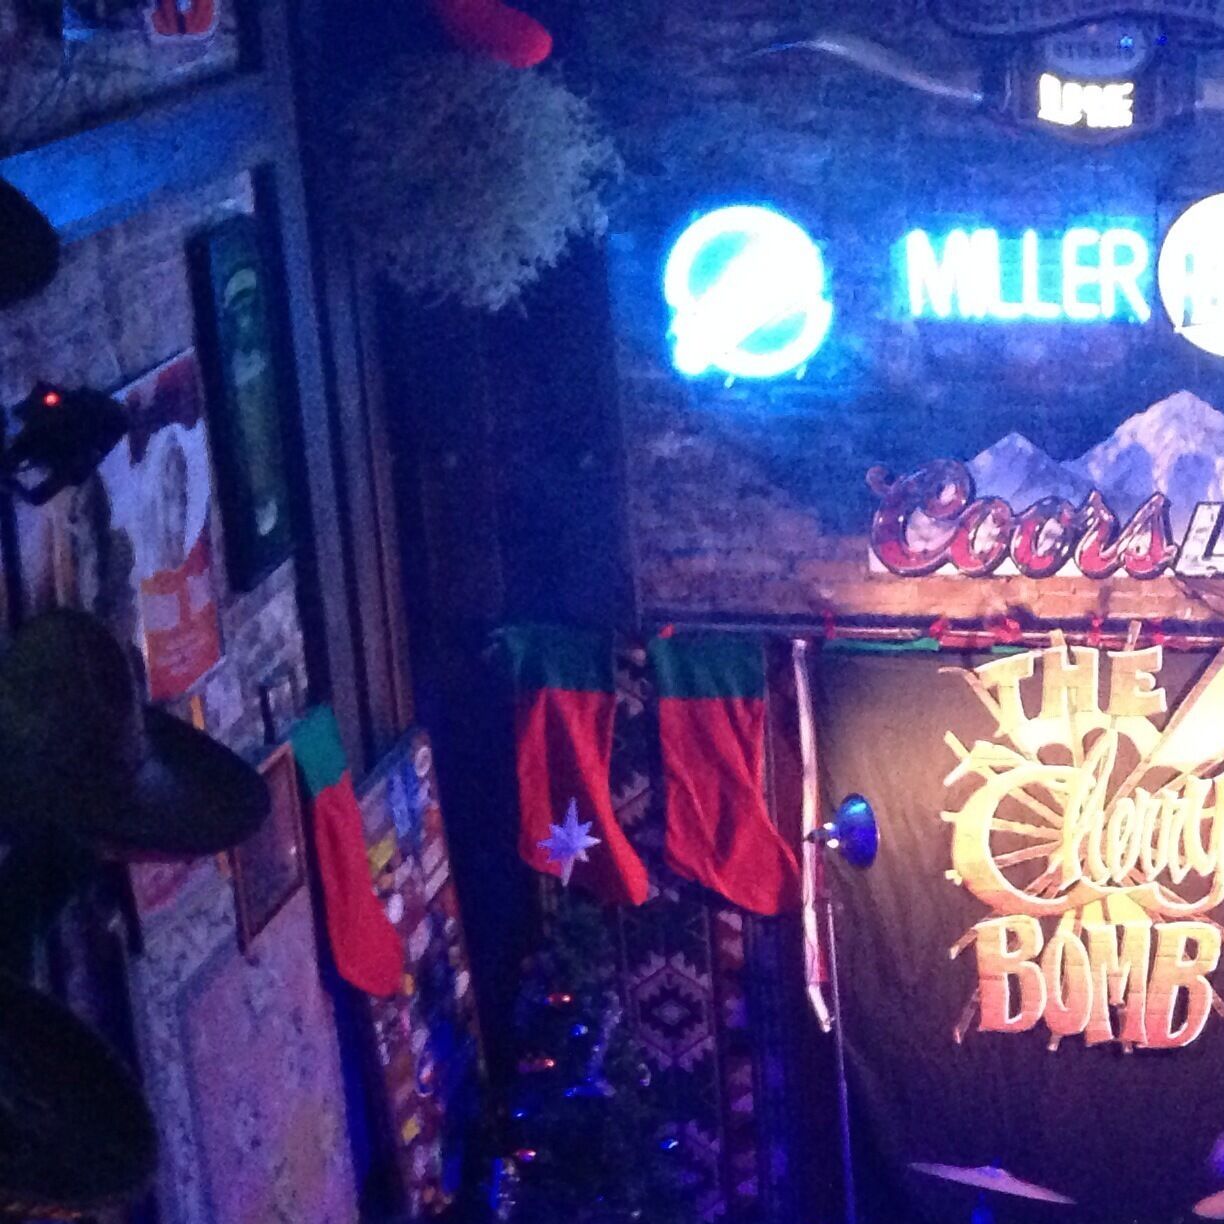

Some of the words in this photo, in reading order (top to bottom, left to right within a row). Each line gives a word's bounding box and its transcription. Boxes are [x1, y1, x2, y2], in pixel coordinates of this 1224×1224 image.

[904, 227, 1150, 325] MILLER
[866, 460, 1177, 578] Coors
[974, 645, 1168, 736] THE
[975, 914, 1221, 1048] BOMB
